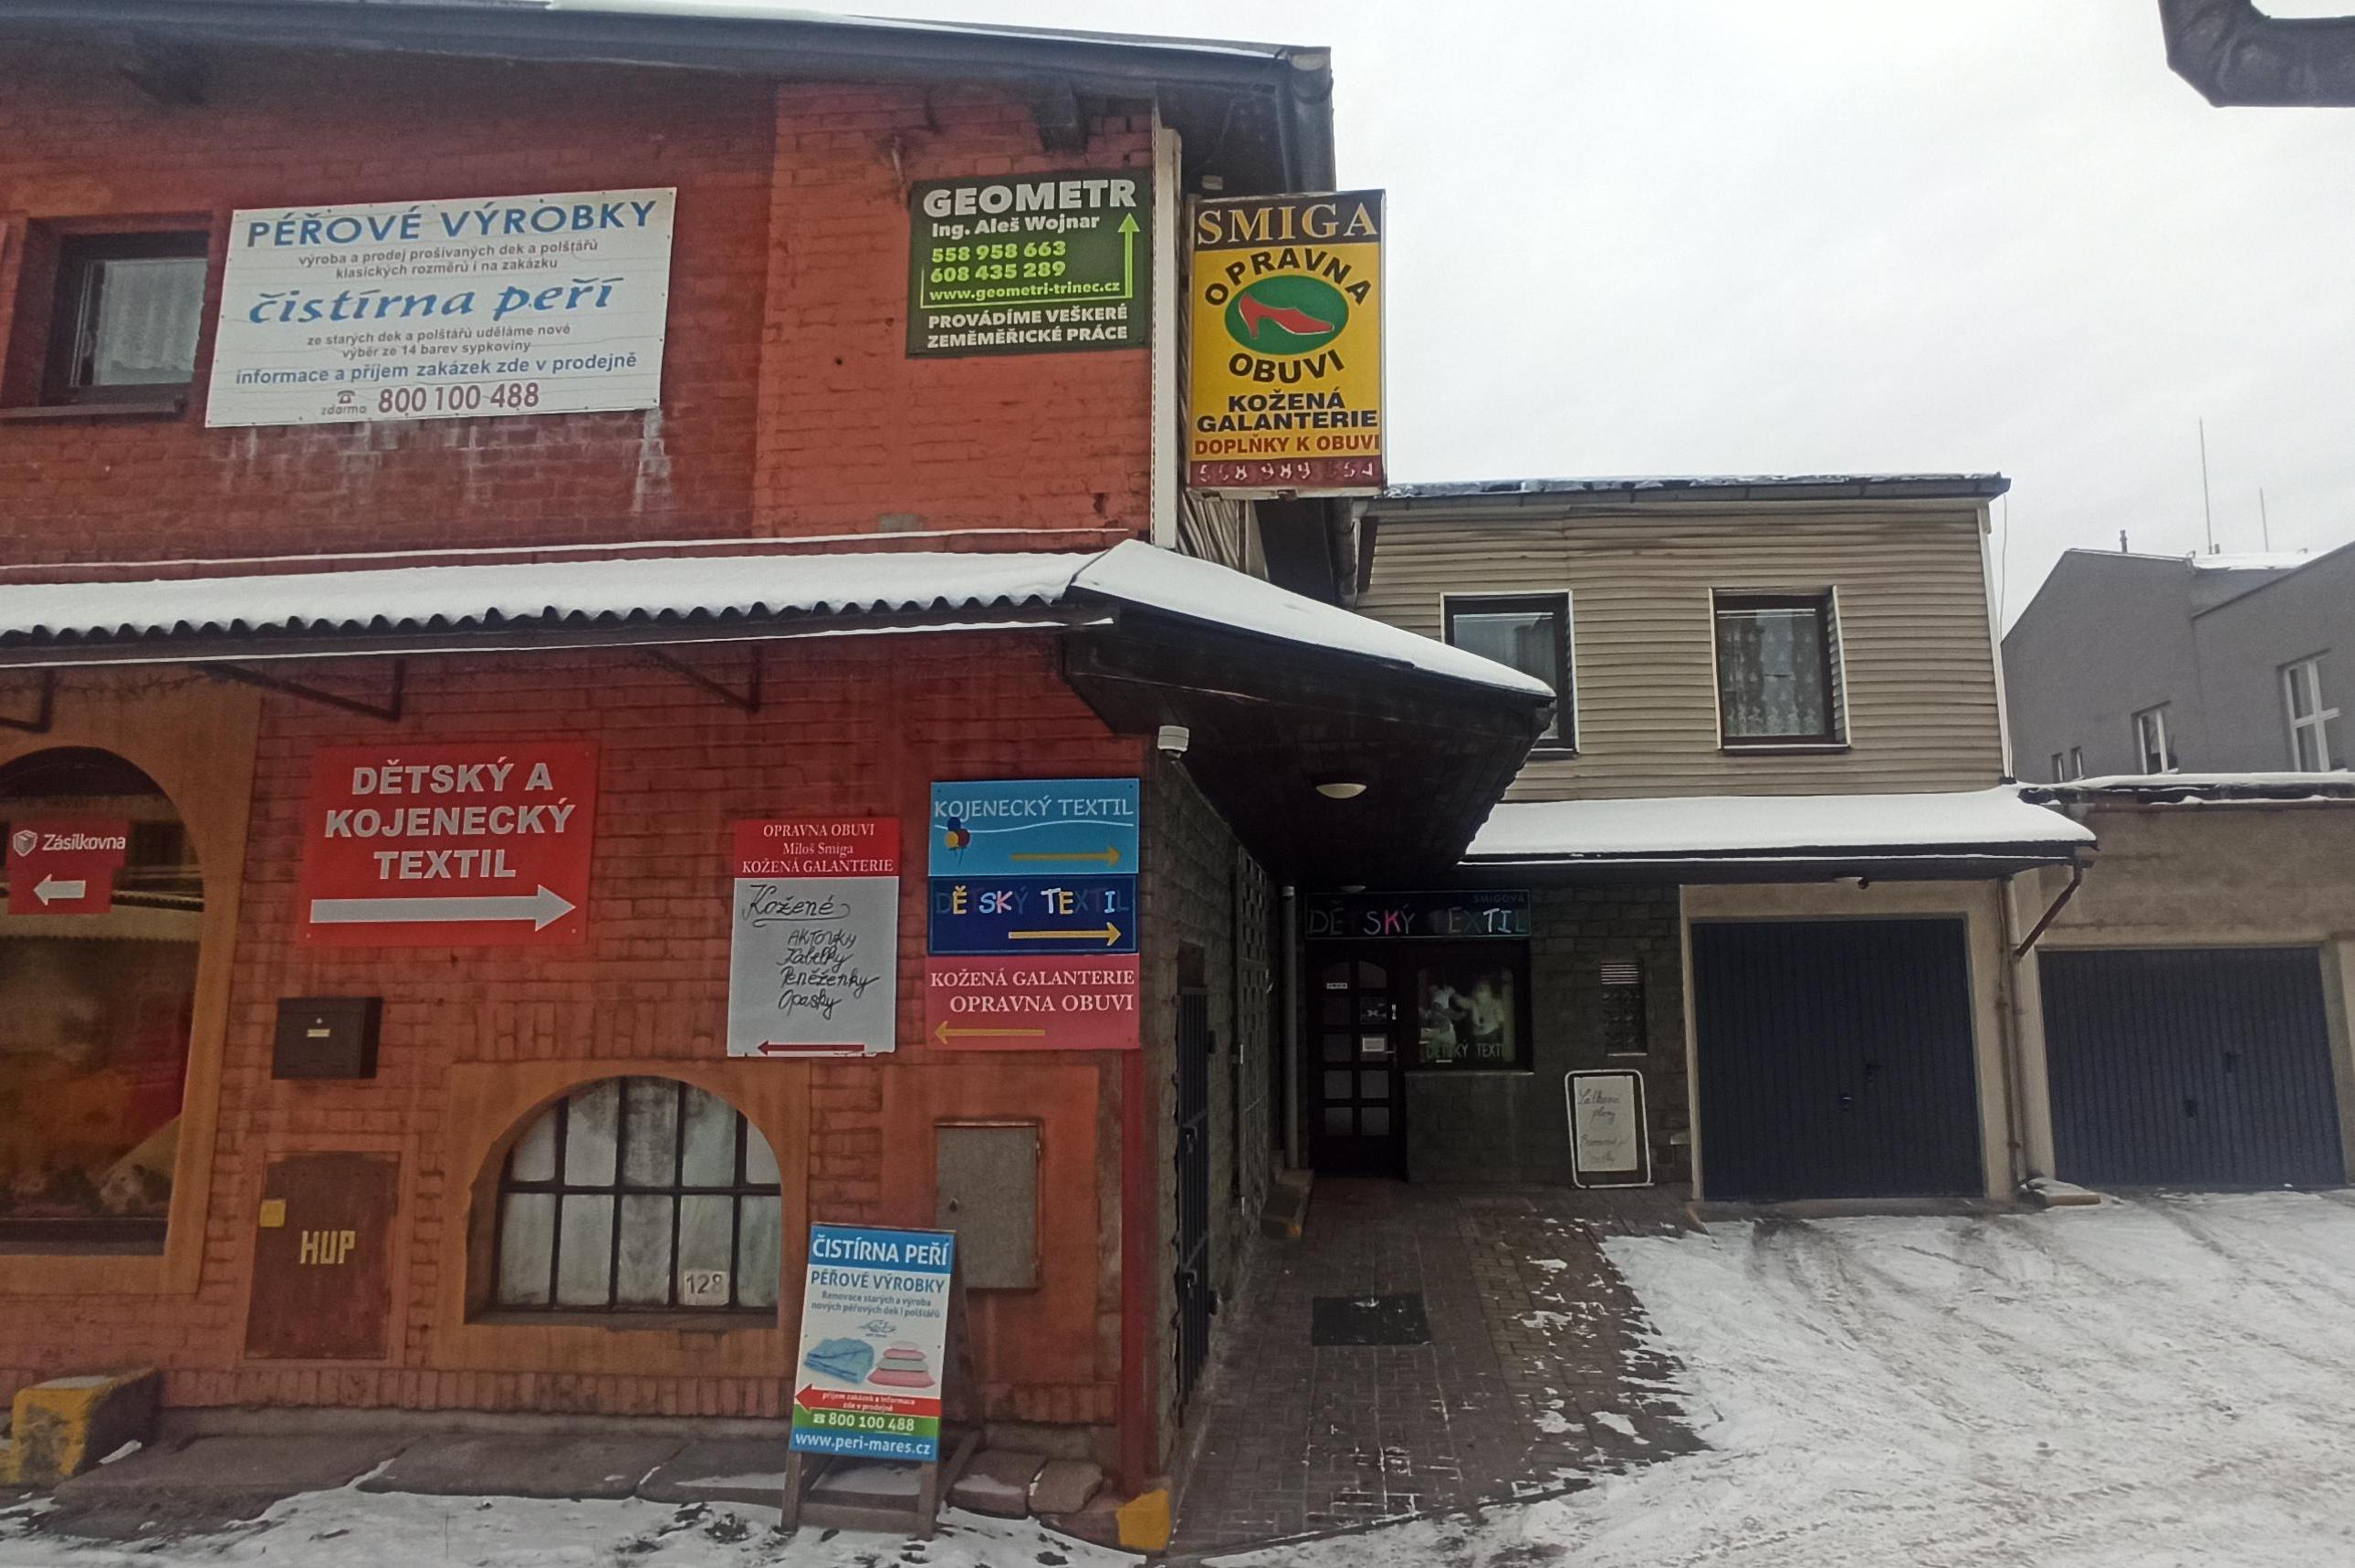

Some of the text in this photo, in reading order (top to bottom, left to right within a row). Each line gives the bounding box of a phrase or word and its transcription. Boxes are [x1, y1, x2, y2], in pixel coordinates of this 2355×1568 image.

[923, 179, 1136, 218] GEOMETR
[246, 201, 657, 247] PÉŘOVÉ VÝROBKY
[932, 214, 1100, 240] Ing. Aleš Wojnar
[1198, 202, 1378, 245] SMIGA
[298, 239, 599, 268] výroba a prodej prošívaných dek a polštářů
[932, 241, 1066, 263] 558 958 663
[336, 256, 558, 279] klasických rozměrů i na zakázku
[930, 261, 1066, 283] 608 435 289
[1205, 247, 1372, 306] OPRAVNA
[248, 277, 624, 324] čistírna peří
[929, 281, 1121, 301] www.geometri-trinec.cz
[928, 303, 1127, 329] PROVÁDÍME VEŠKERÉ
[307, 323, 570, 346] ze starých dek a polštářů uděláme nové
[926, 323, 1127, 349] ZEMĚMĚŘICKÉ PRÁCE
[342, 340, 531, 361] výběr ze 14 barev sypkoviny
[236, 351, 637, 384] informace a příjem zakázek zde v prodejně
[1229, 349, 1345, 384] OBUVI
[321, 404, 367, 416] zdarma
[378, 382, 539, 413] 800 100 488
[1229, 386, 1345, 413] KOŽENÁ
[1197, 410, 1377, 433] GALANTERIE
[1195, 434, 1380, 455] DOPLŇKY K OBUVI
[351, 756, 554, 795] DĚTSKÝ A
[324, 797, 576, 838] KOJENECKÝ
[935, 795, 1134, 821] KOJENECKÝ TEXTIL
[42, 832, 126, 852] Zásilkovna
[763, 823, 874, 837] OPRAVNA OBUVI
[782, 841, 853, 858] Miloš Smiga
[373, 849, 517, 880] TEXTIL
[742, 857, 894, 873] KOŽENÁ GALANTERIE
[742, 884, 838, 920] Kožené
[930, 968, 1135, 988] KOŽENÁ GALANTERIE
[949, 994, 1134, 1013] OPRAVNA OBUVI
[299, 1230, 356, 1265] HUP
[812, 1234, 950, 1266] ČISTÍRNA PEŘÍ
[686, 1273, 723, 1294] 128
[811, 1268, 945, 1293] PÉŘOVÉ VÝROBKY
[828, 1413, 915, 1432] 800 100 488
[795, 1433, 931, 1456] www.peri-mares.cz
